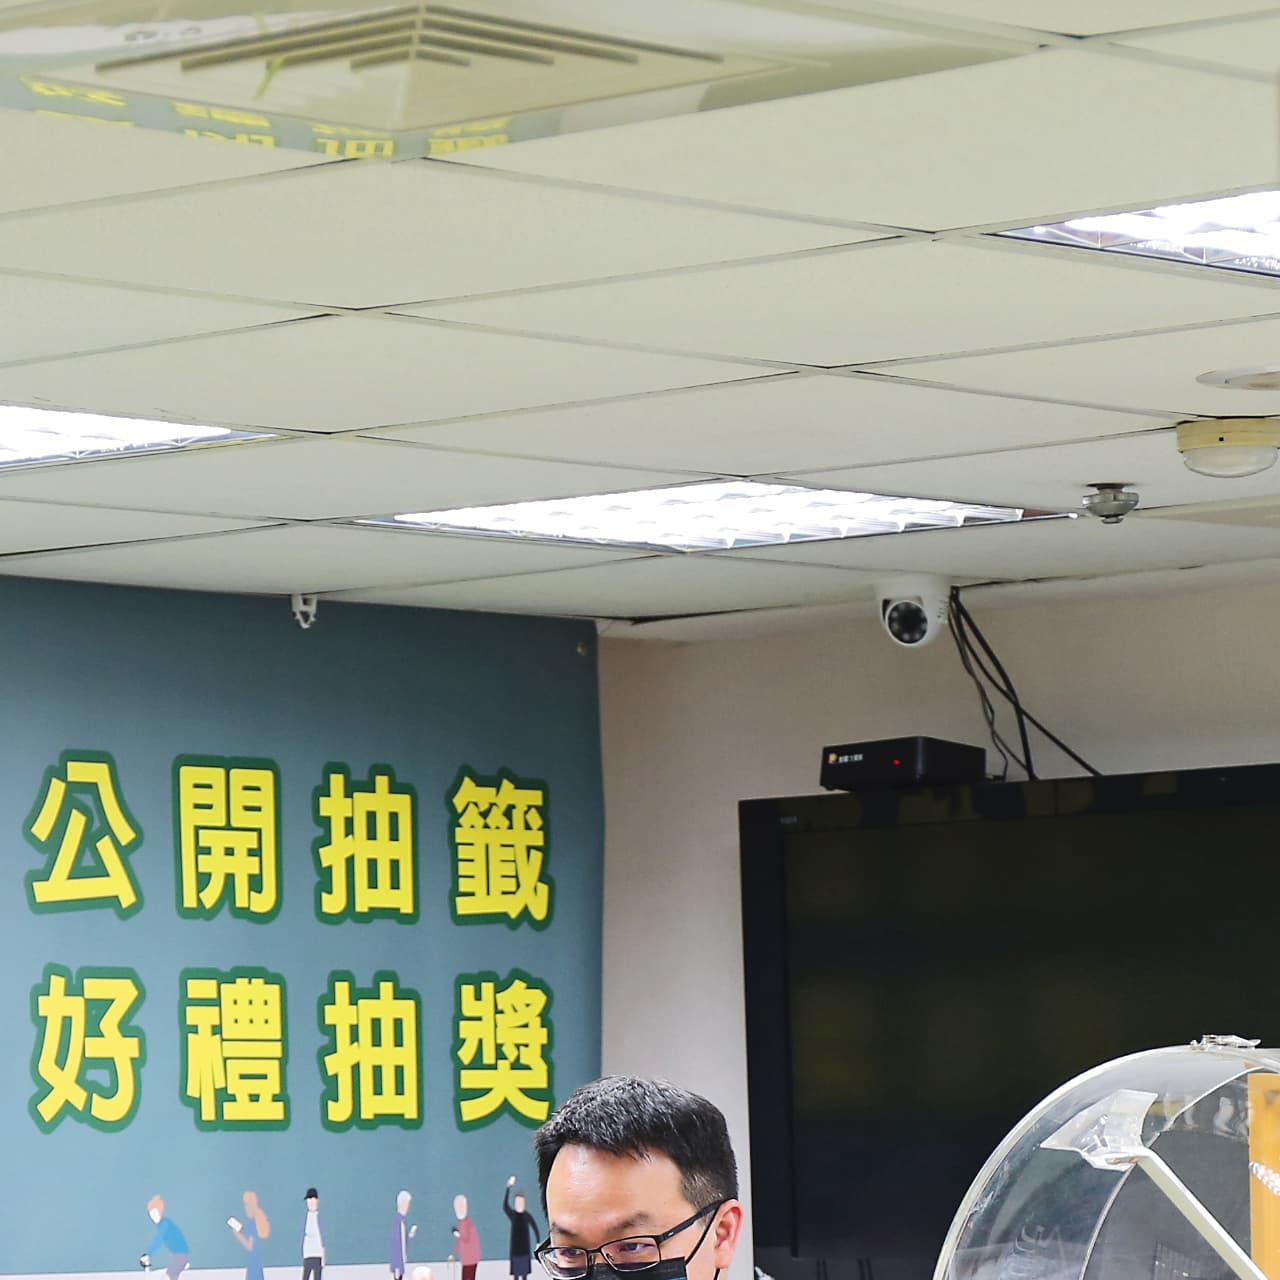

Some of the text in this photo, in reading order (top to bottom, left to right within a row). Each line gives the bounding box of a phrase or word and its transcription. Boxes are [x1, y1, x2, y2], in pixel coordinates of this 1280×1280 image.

[28, 756, 551, 926] 公開抽籤
[32, 969, 553, 1128] 好禮抽獎
